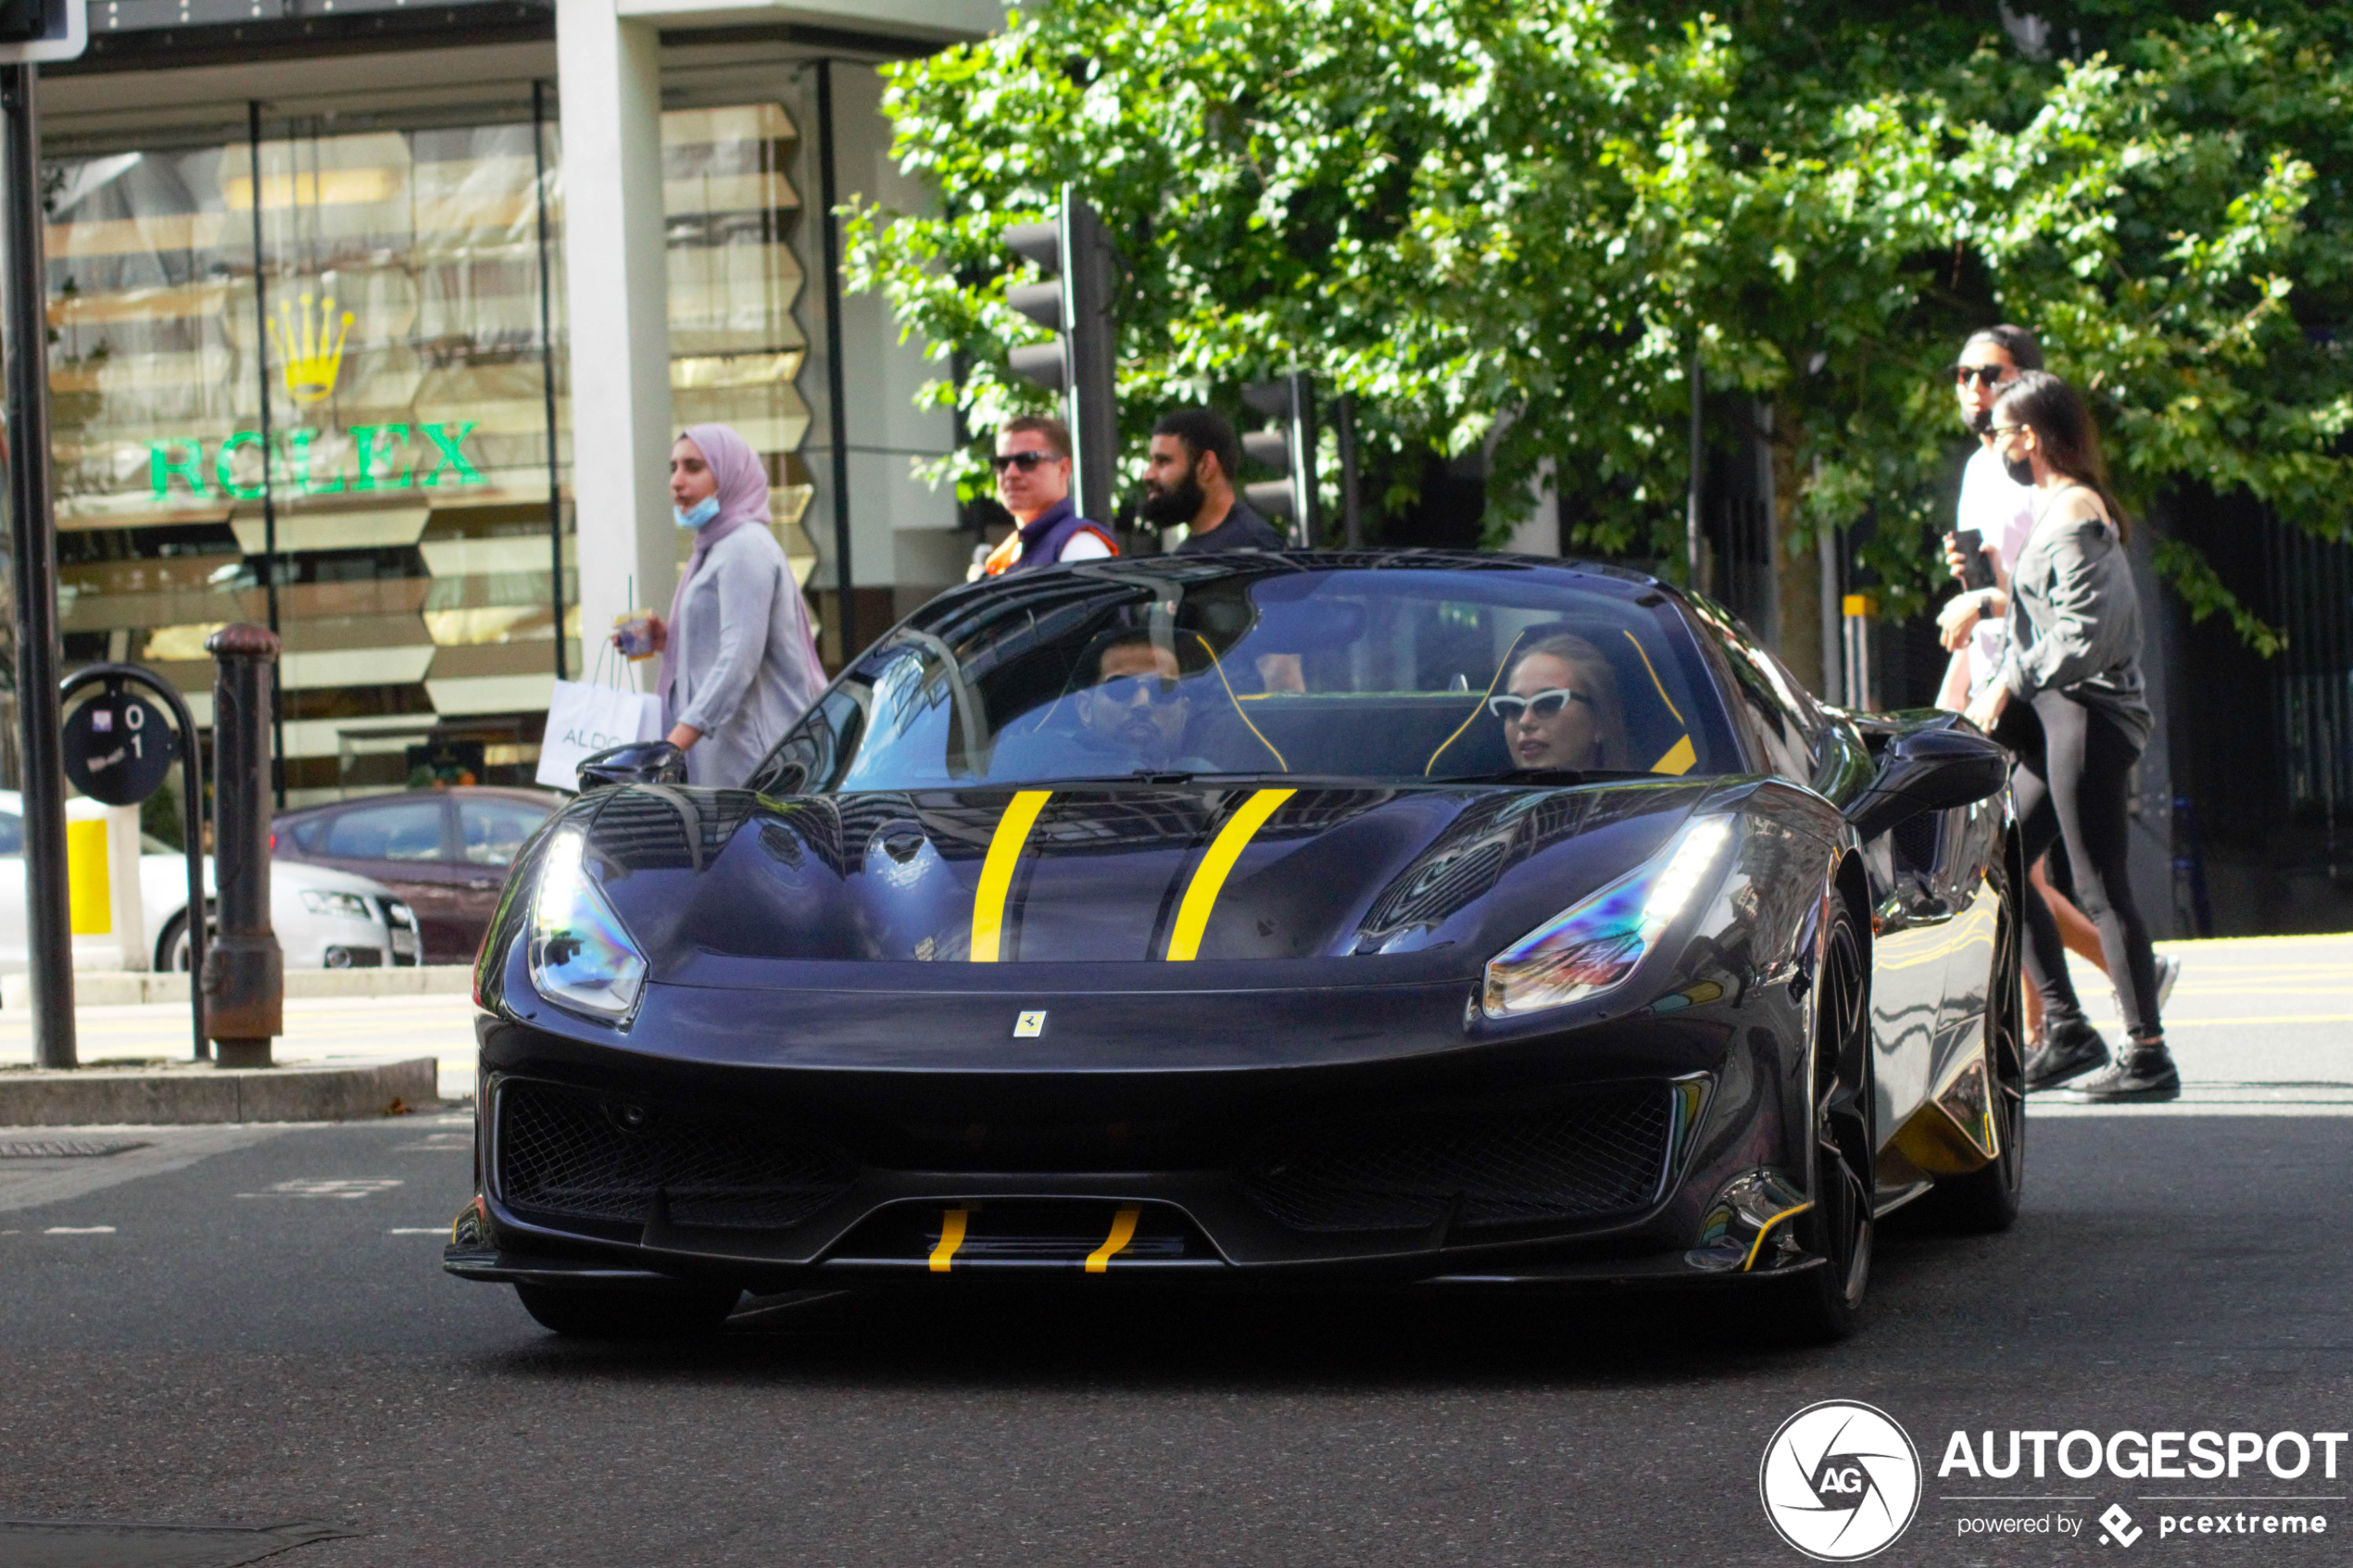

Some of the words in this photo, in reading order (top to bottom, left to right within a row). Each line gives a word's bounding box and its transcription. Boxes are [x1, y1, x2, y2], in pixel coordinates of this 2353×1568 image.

[143, 420, 487, 502] ROLEX
[125, 704, 144, 730] 0
[132, 734, 142, 759] 1
